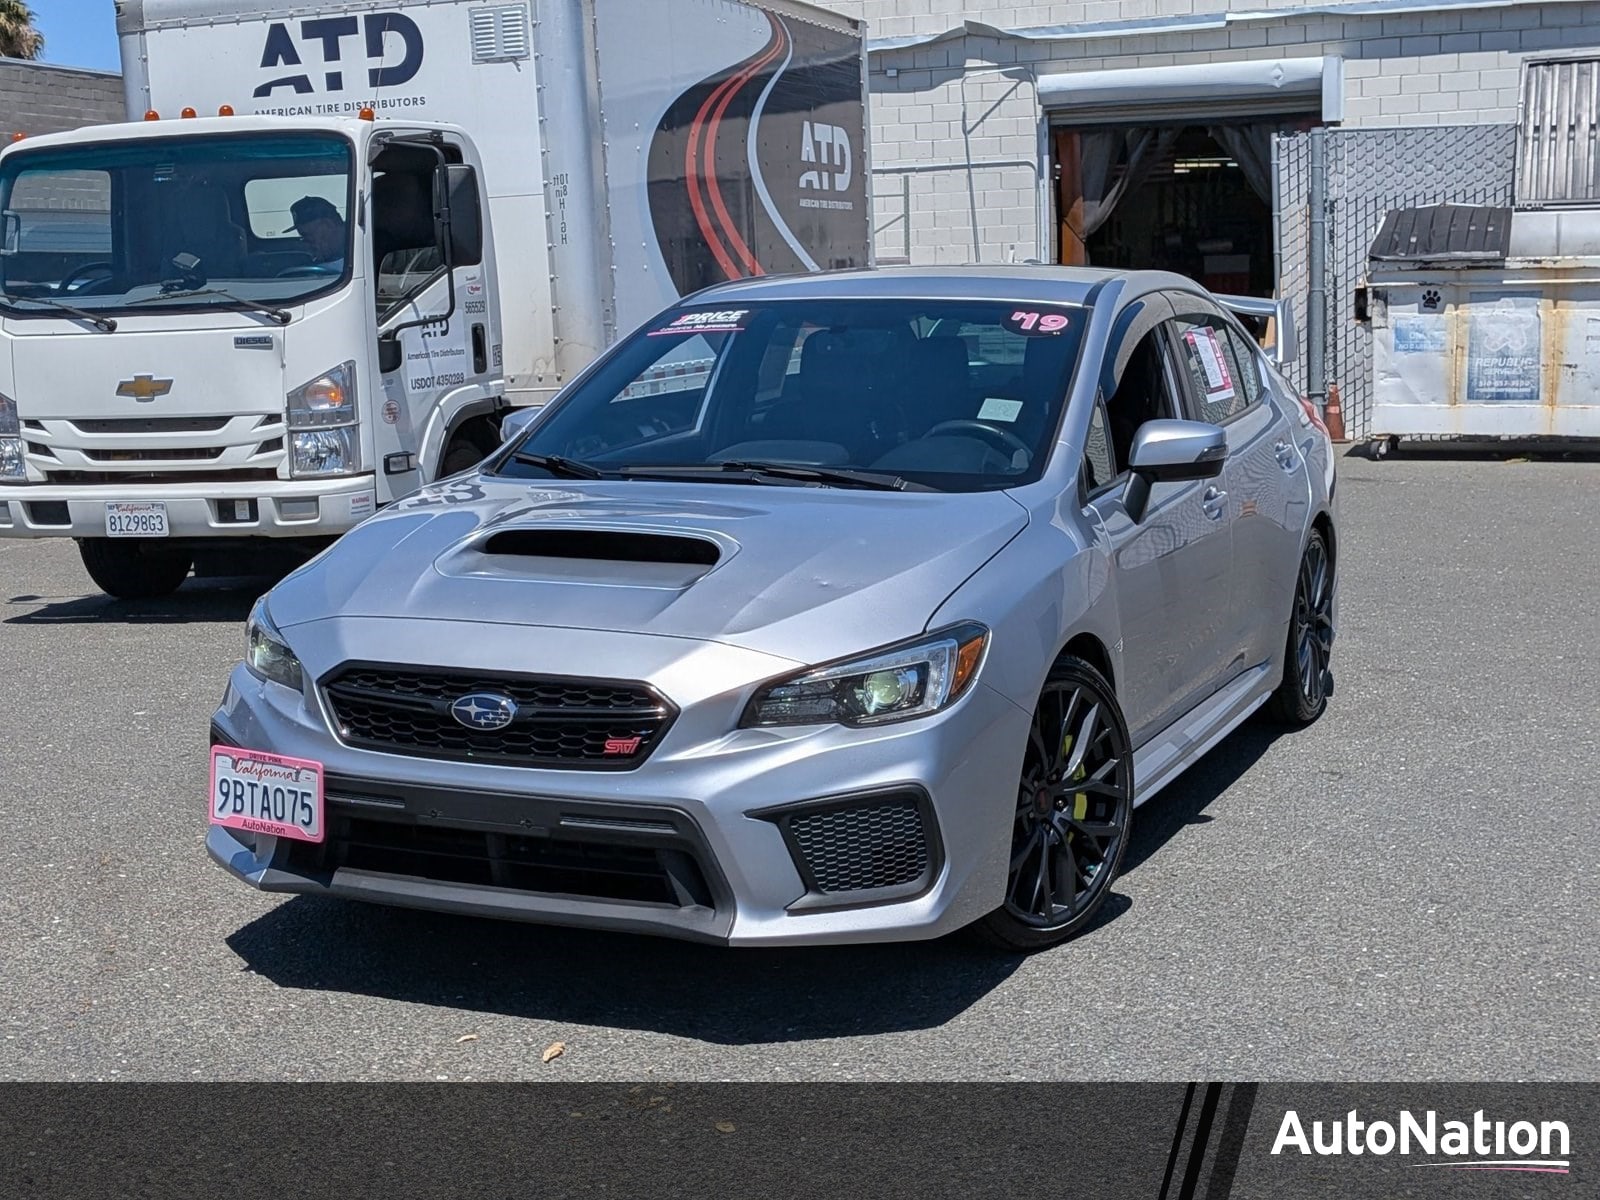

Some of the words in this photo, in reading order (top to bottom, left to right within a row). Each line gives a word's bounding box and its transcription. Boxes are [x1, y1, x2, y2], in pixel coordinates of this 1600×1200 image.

[252, 12, 424, 98] ATD
[316, 103, 340, 114] TIRE
[344, 96, 426, 112] DISTRIBUTORS
[799, 120, 852, 192] ATD
[1011, 311, 1069, 331] '19
[407, 350, 431, 361] American
[431, 349, 440, 358] Tire
[440, 347, 465, 358] Distributors
[1475, 357, 1534, 368] REPUBLIC
[410, 375, 435, 390] USDOT
[109, 514, 164, 532] 81298G3
[234, 760, 294, 781] California
[218, 777, 313, 826] 9BTA075
